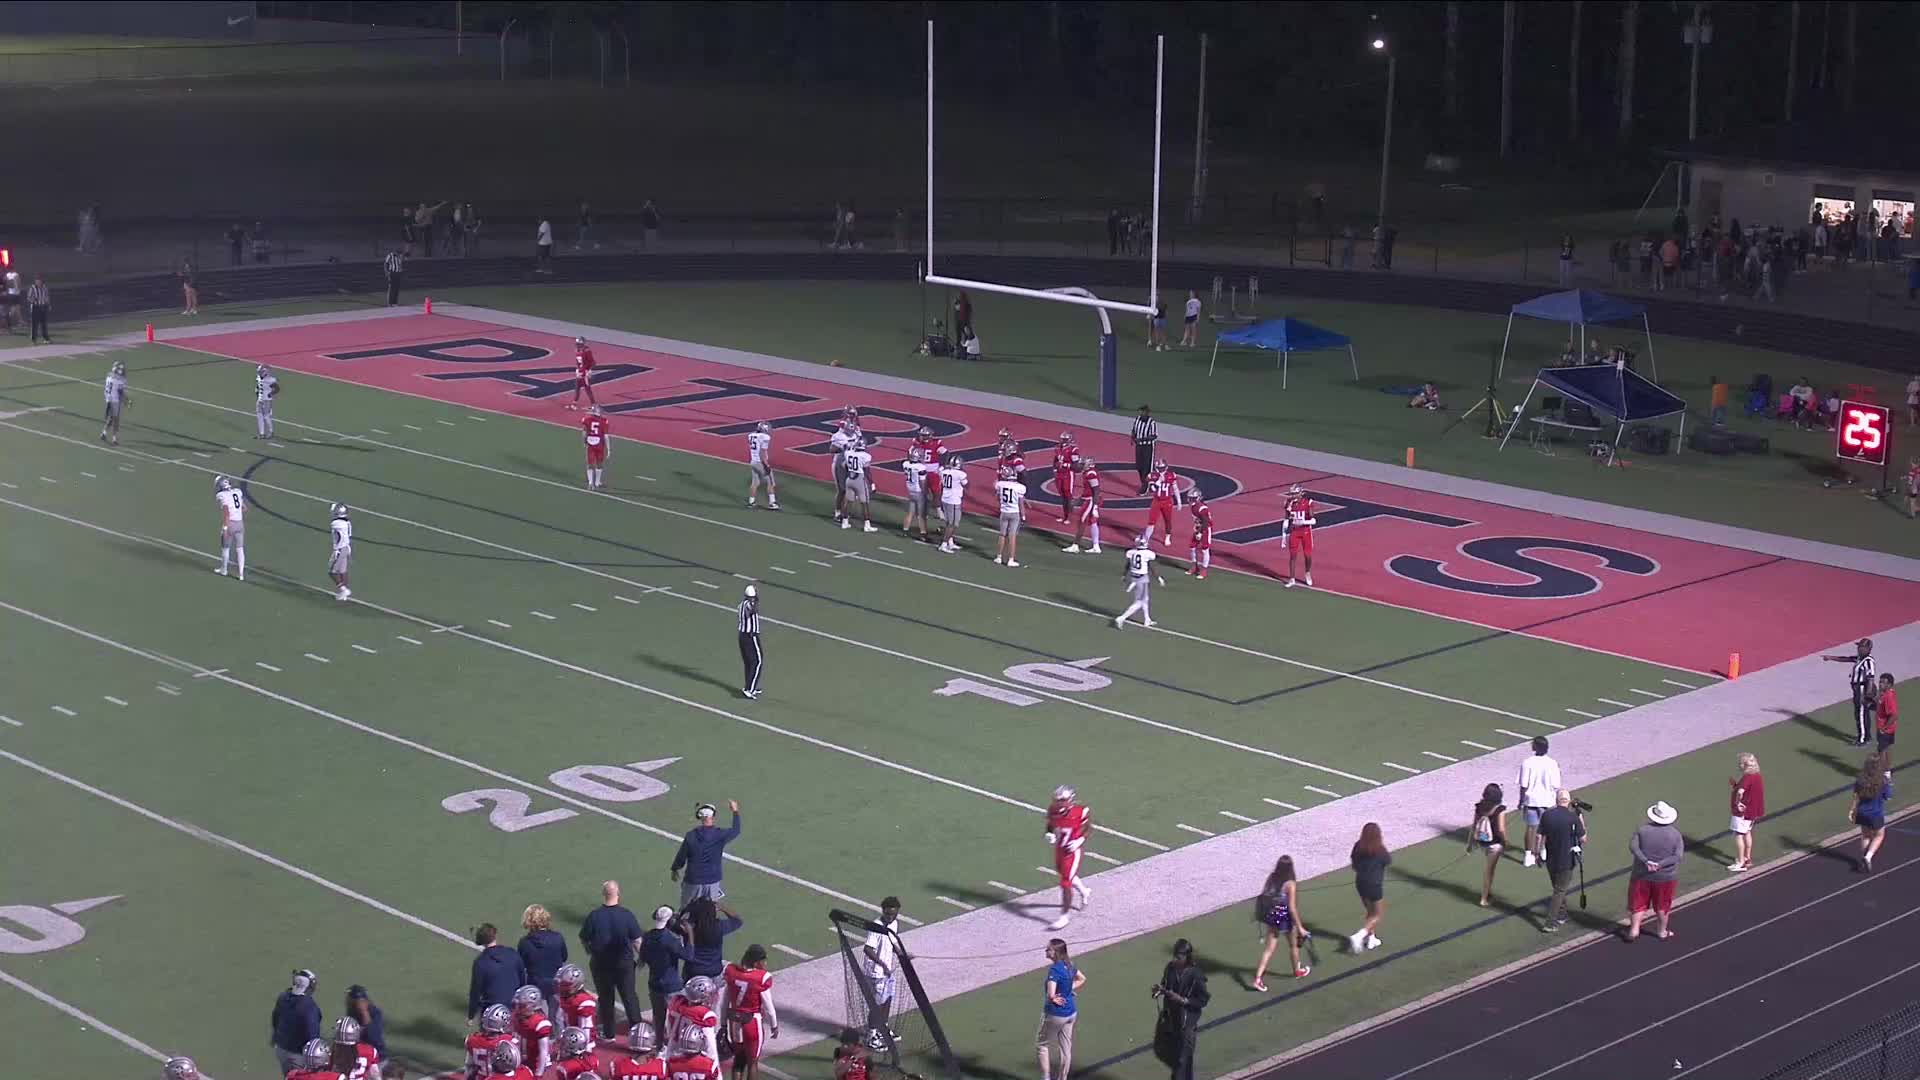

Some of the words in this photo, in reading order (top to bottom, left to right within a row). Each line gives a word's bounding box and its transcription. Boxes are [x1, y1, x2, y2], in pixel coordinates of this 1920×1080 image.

[590, 422, 600, 435] 5
[1845, 409, 1881, 449] 25
[848, 455, 859, 471] 50
[232, 493, 240, 509] 8
[1002, 487, 1013, 503] 51
[933, 662, 1112, 706] 10
[441, 764, 670, 832] 20
[735, 979, 749, 998] 7
